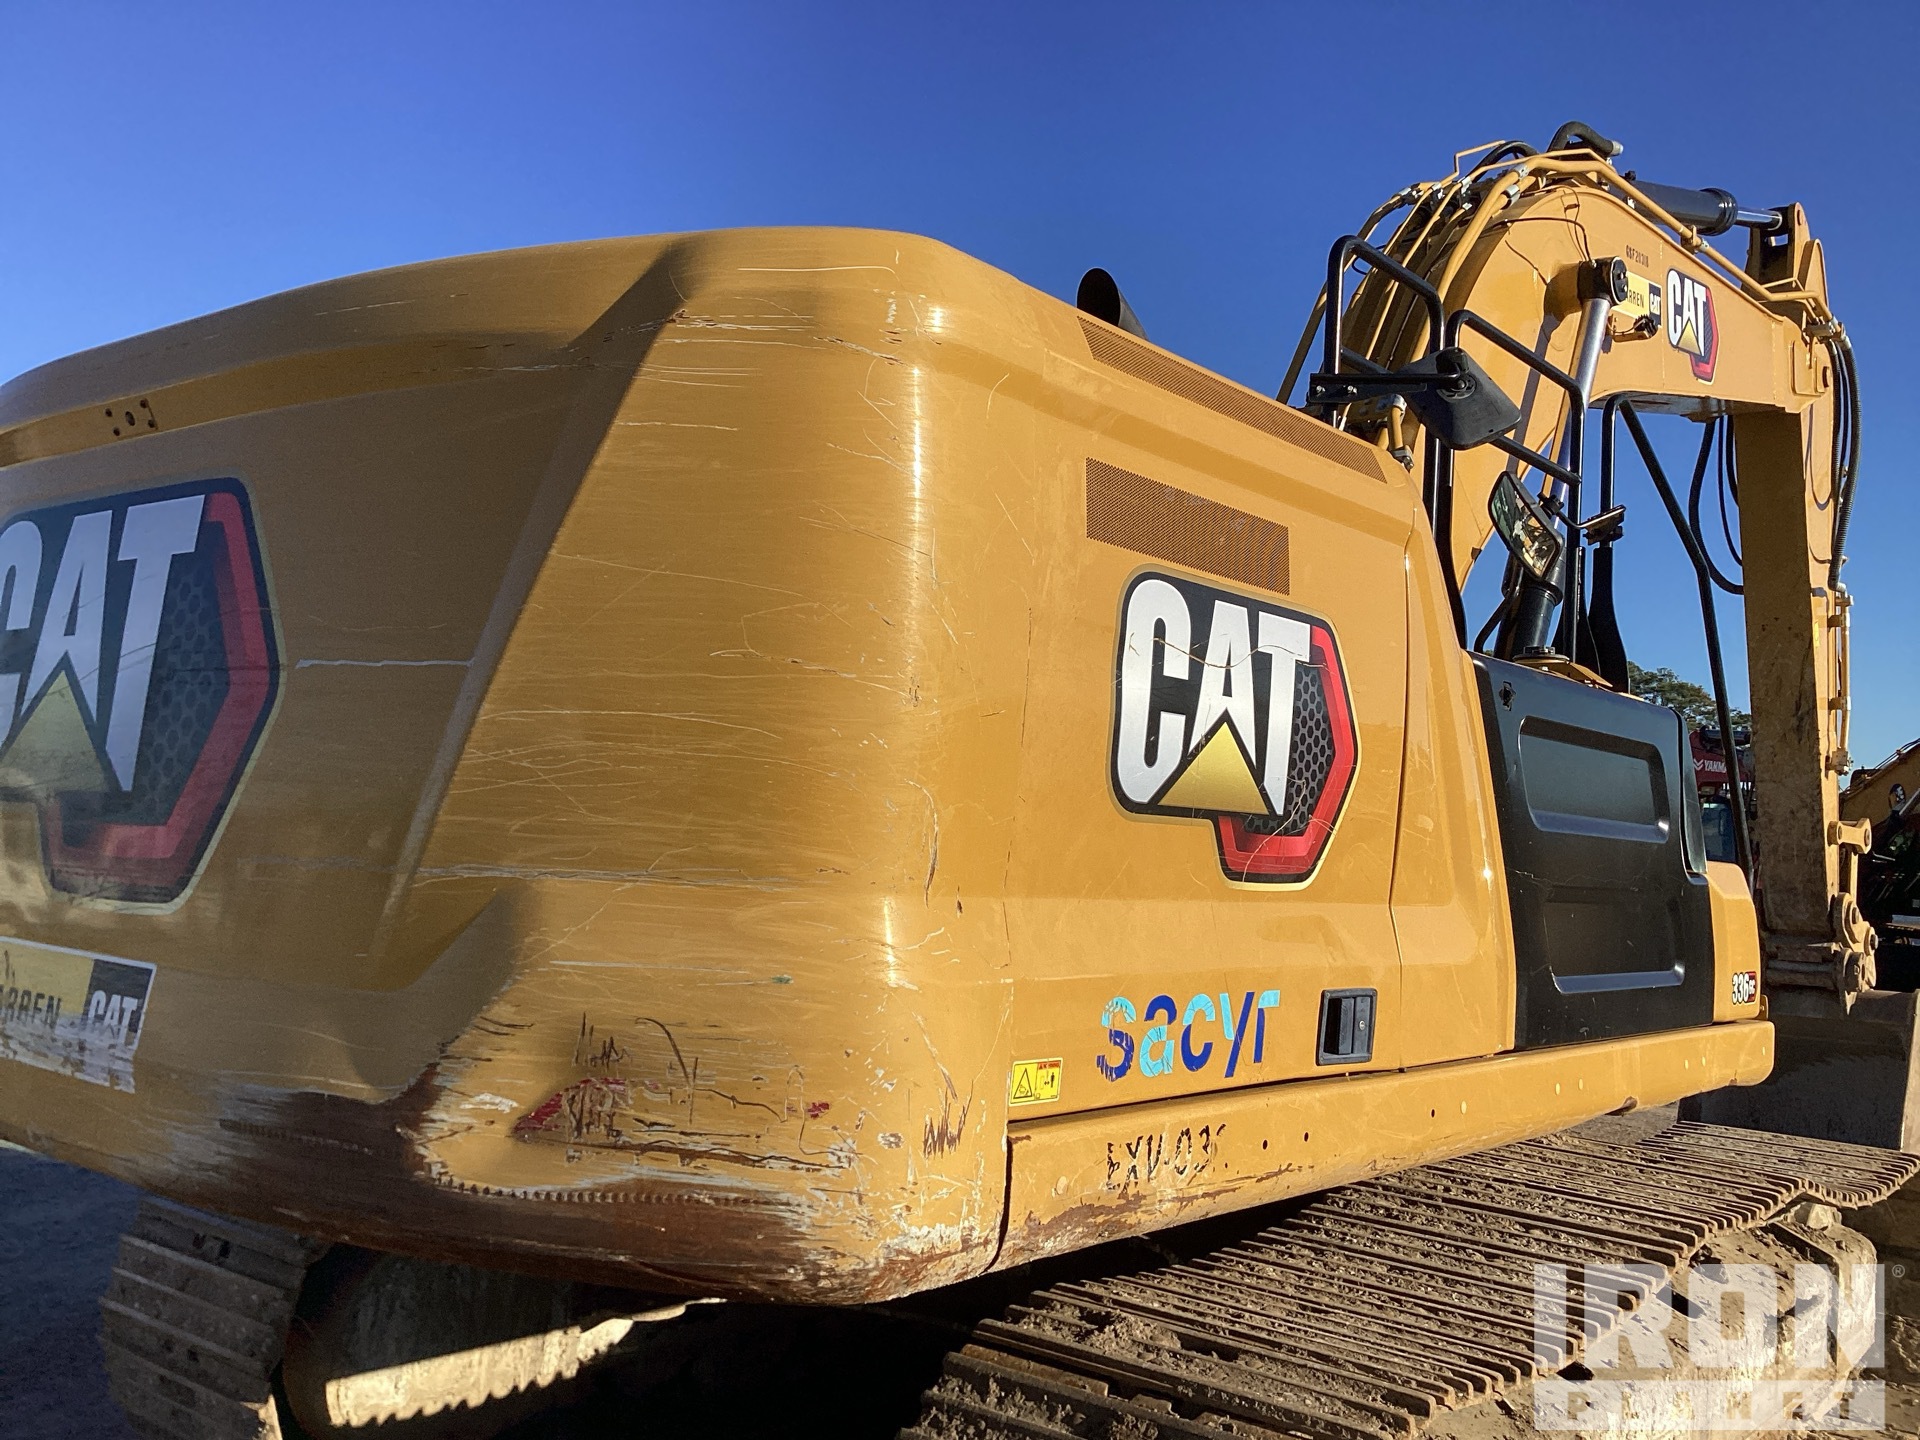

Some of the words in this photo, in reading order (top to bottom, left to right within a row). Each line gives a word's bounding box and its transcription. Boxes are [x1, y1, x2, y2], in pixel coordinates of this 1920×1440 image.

[1627, 289, 1645, 309] RREN
[1667, 270, 1707, 356] CAT
[1117, 579, 1311, 816] CAT
[1732, 972, 1749, 1005] 336
[86, 989, 139, 1046] CAT
